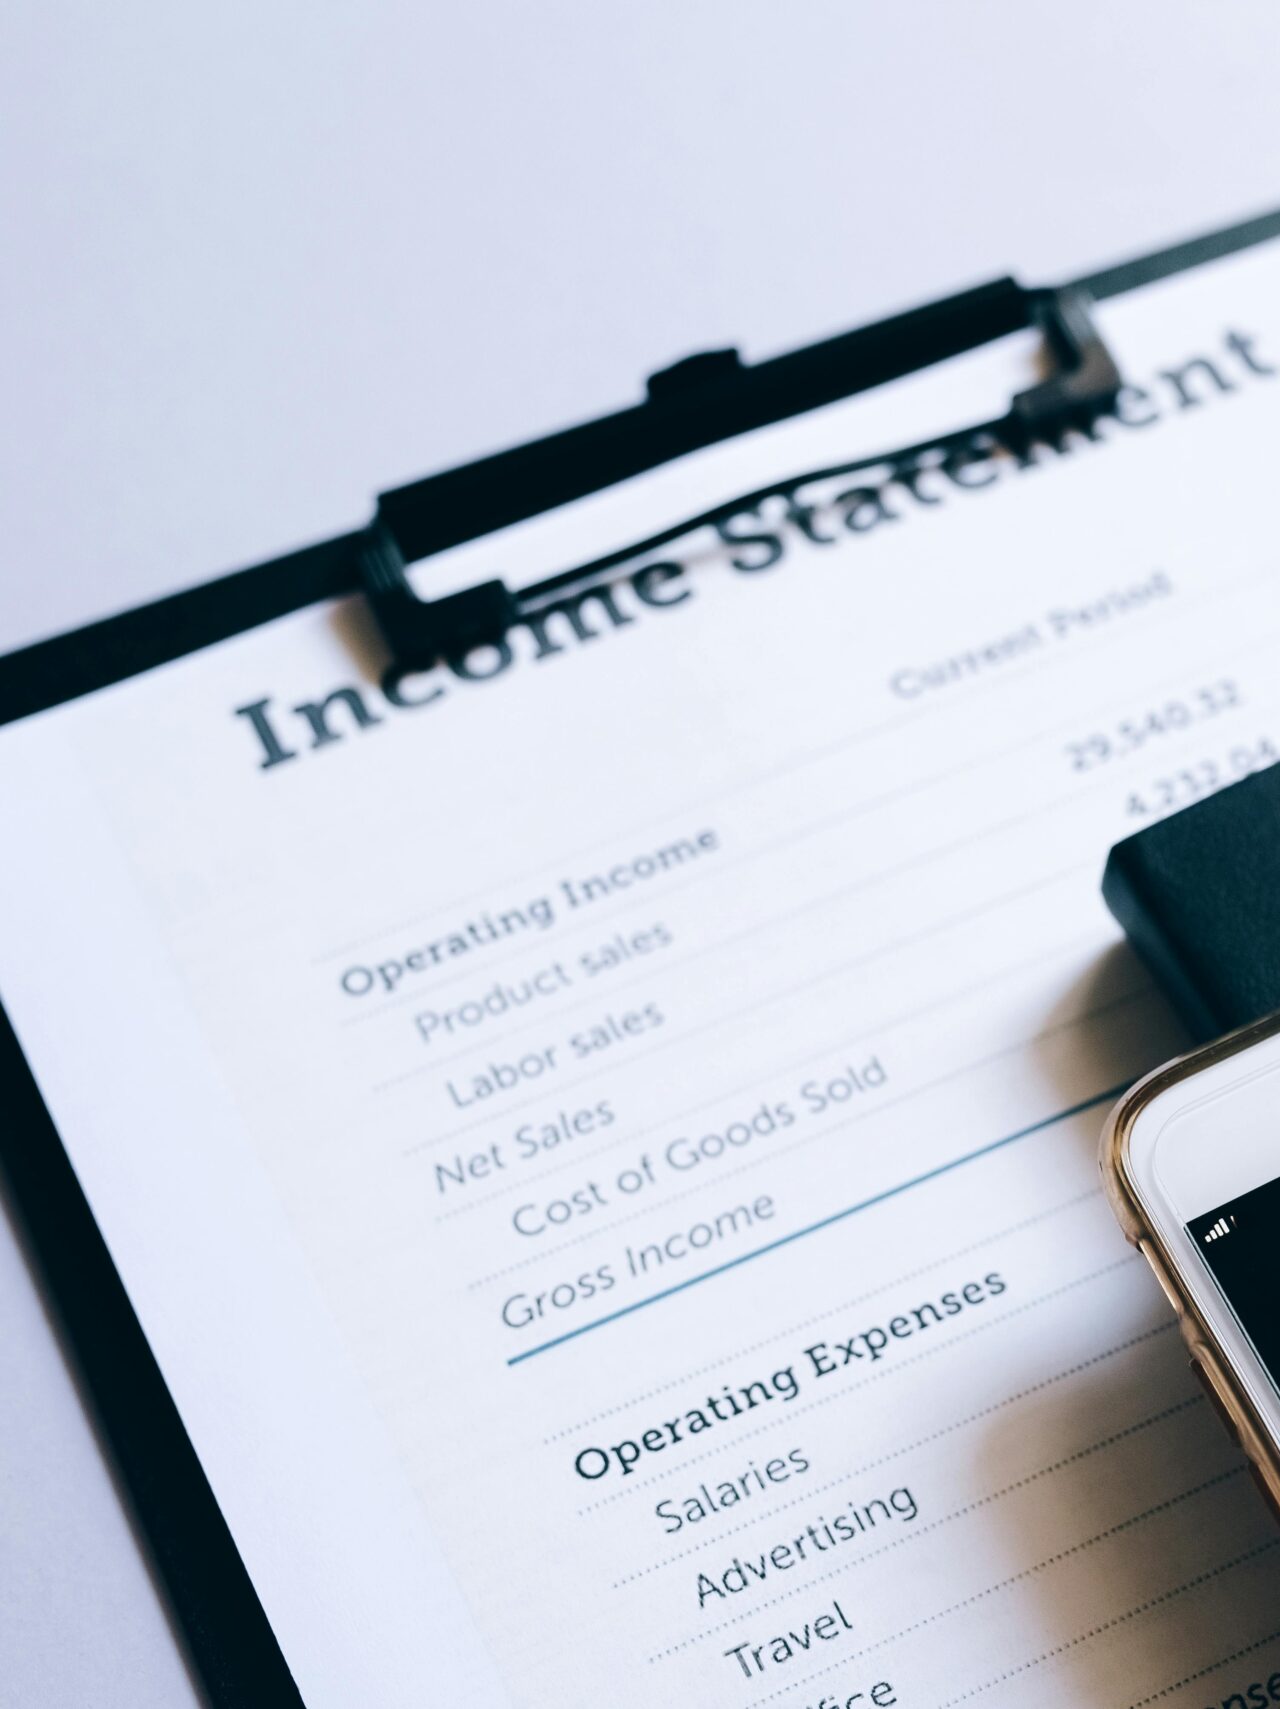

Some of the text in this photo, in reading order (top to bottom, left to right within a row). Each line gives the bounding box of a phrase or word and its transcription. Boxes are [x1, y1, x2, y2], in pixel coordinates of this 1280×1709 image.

[236, 562, 693, 770] Income
[340, 827, 721, 998] Operating Income
[413, 922, 674, 1044] Product sales
[446, 1001, 665, 1110] Labor sales
[435, 1097, 615, 1194] Net Sales
[512, 1056, 889, 1238] Cost of Goods Sold
[501, 1194, 776, 1329] Gross Income
[575, 1272, 1007, 1479] Operating Expenses
[655, 1449, 809, 1534] Salaries
[697, 1487, 918, 1608] Advertising
[724, 1600, 853, 1678] Travel
